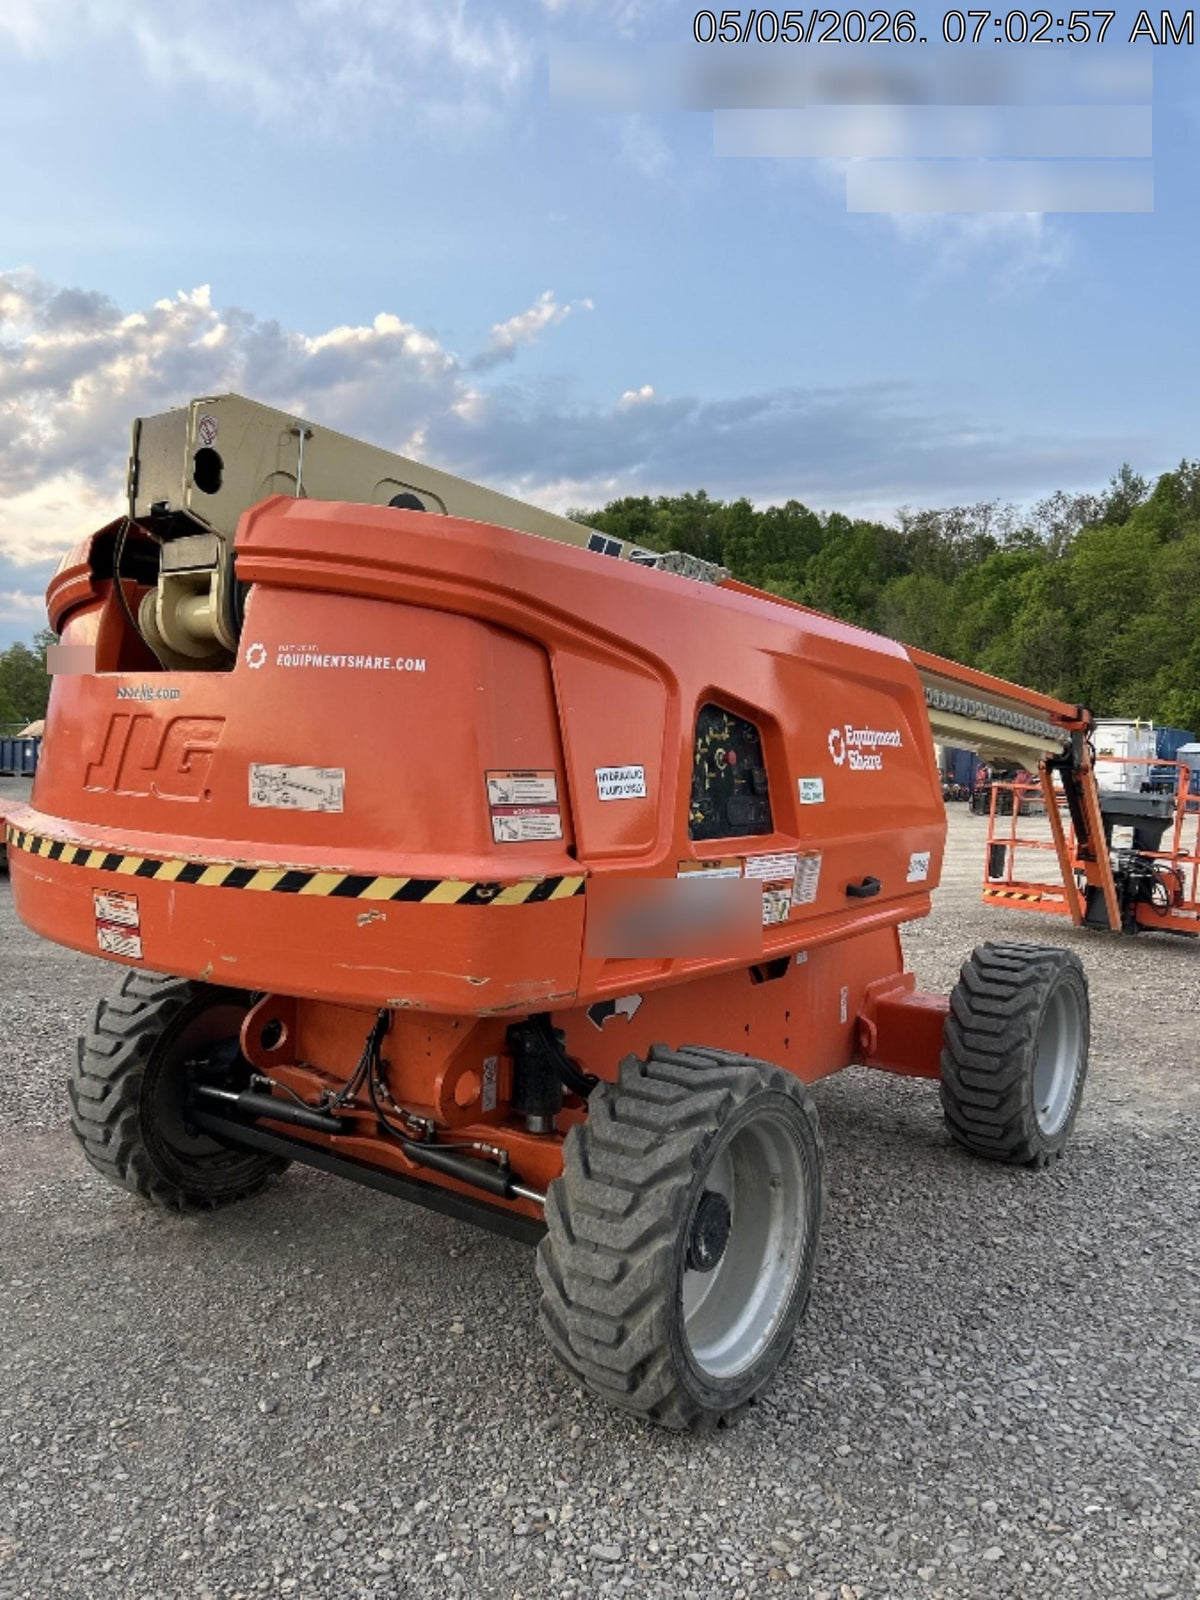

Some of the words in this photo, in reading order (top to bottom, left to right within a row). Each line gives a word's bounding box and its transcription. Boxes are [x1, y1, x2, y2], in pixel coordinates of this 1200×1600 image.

[276, 653, 427, 673] EQUIPMENTSHARE.COM
[844, 724, 903, 751] Equipment
[83, 712, 226, 802] JLG
[848, 749, 883, 771] Share
